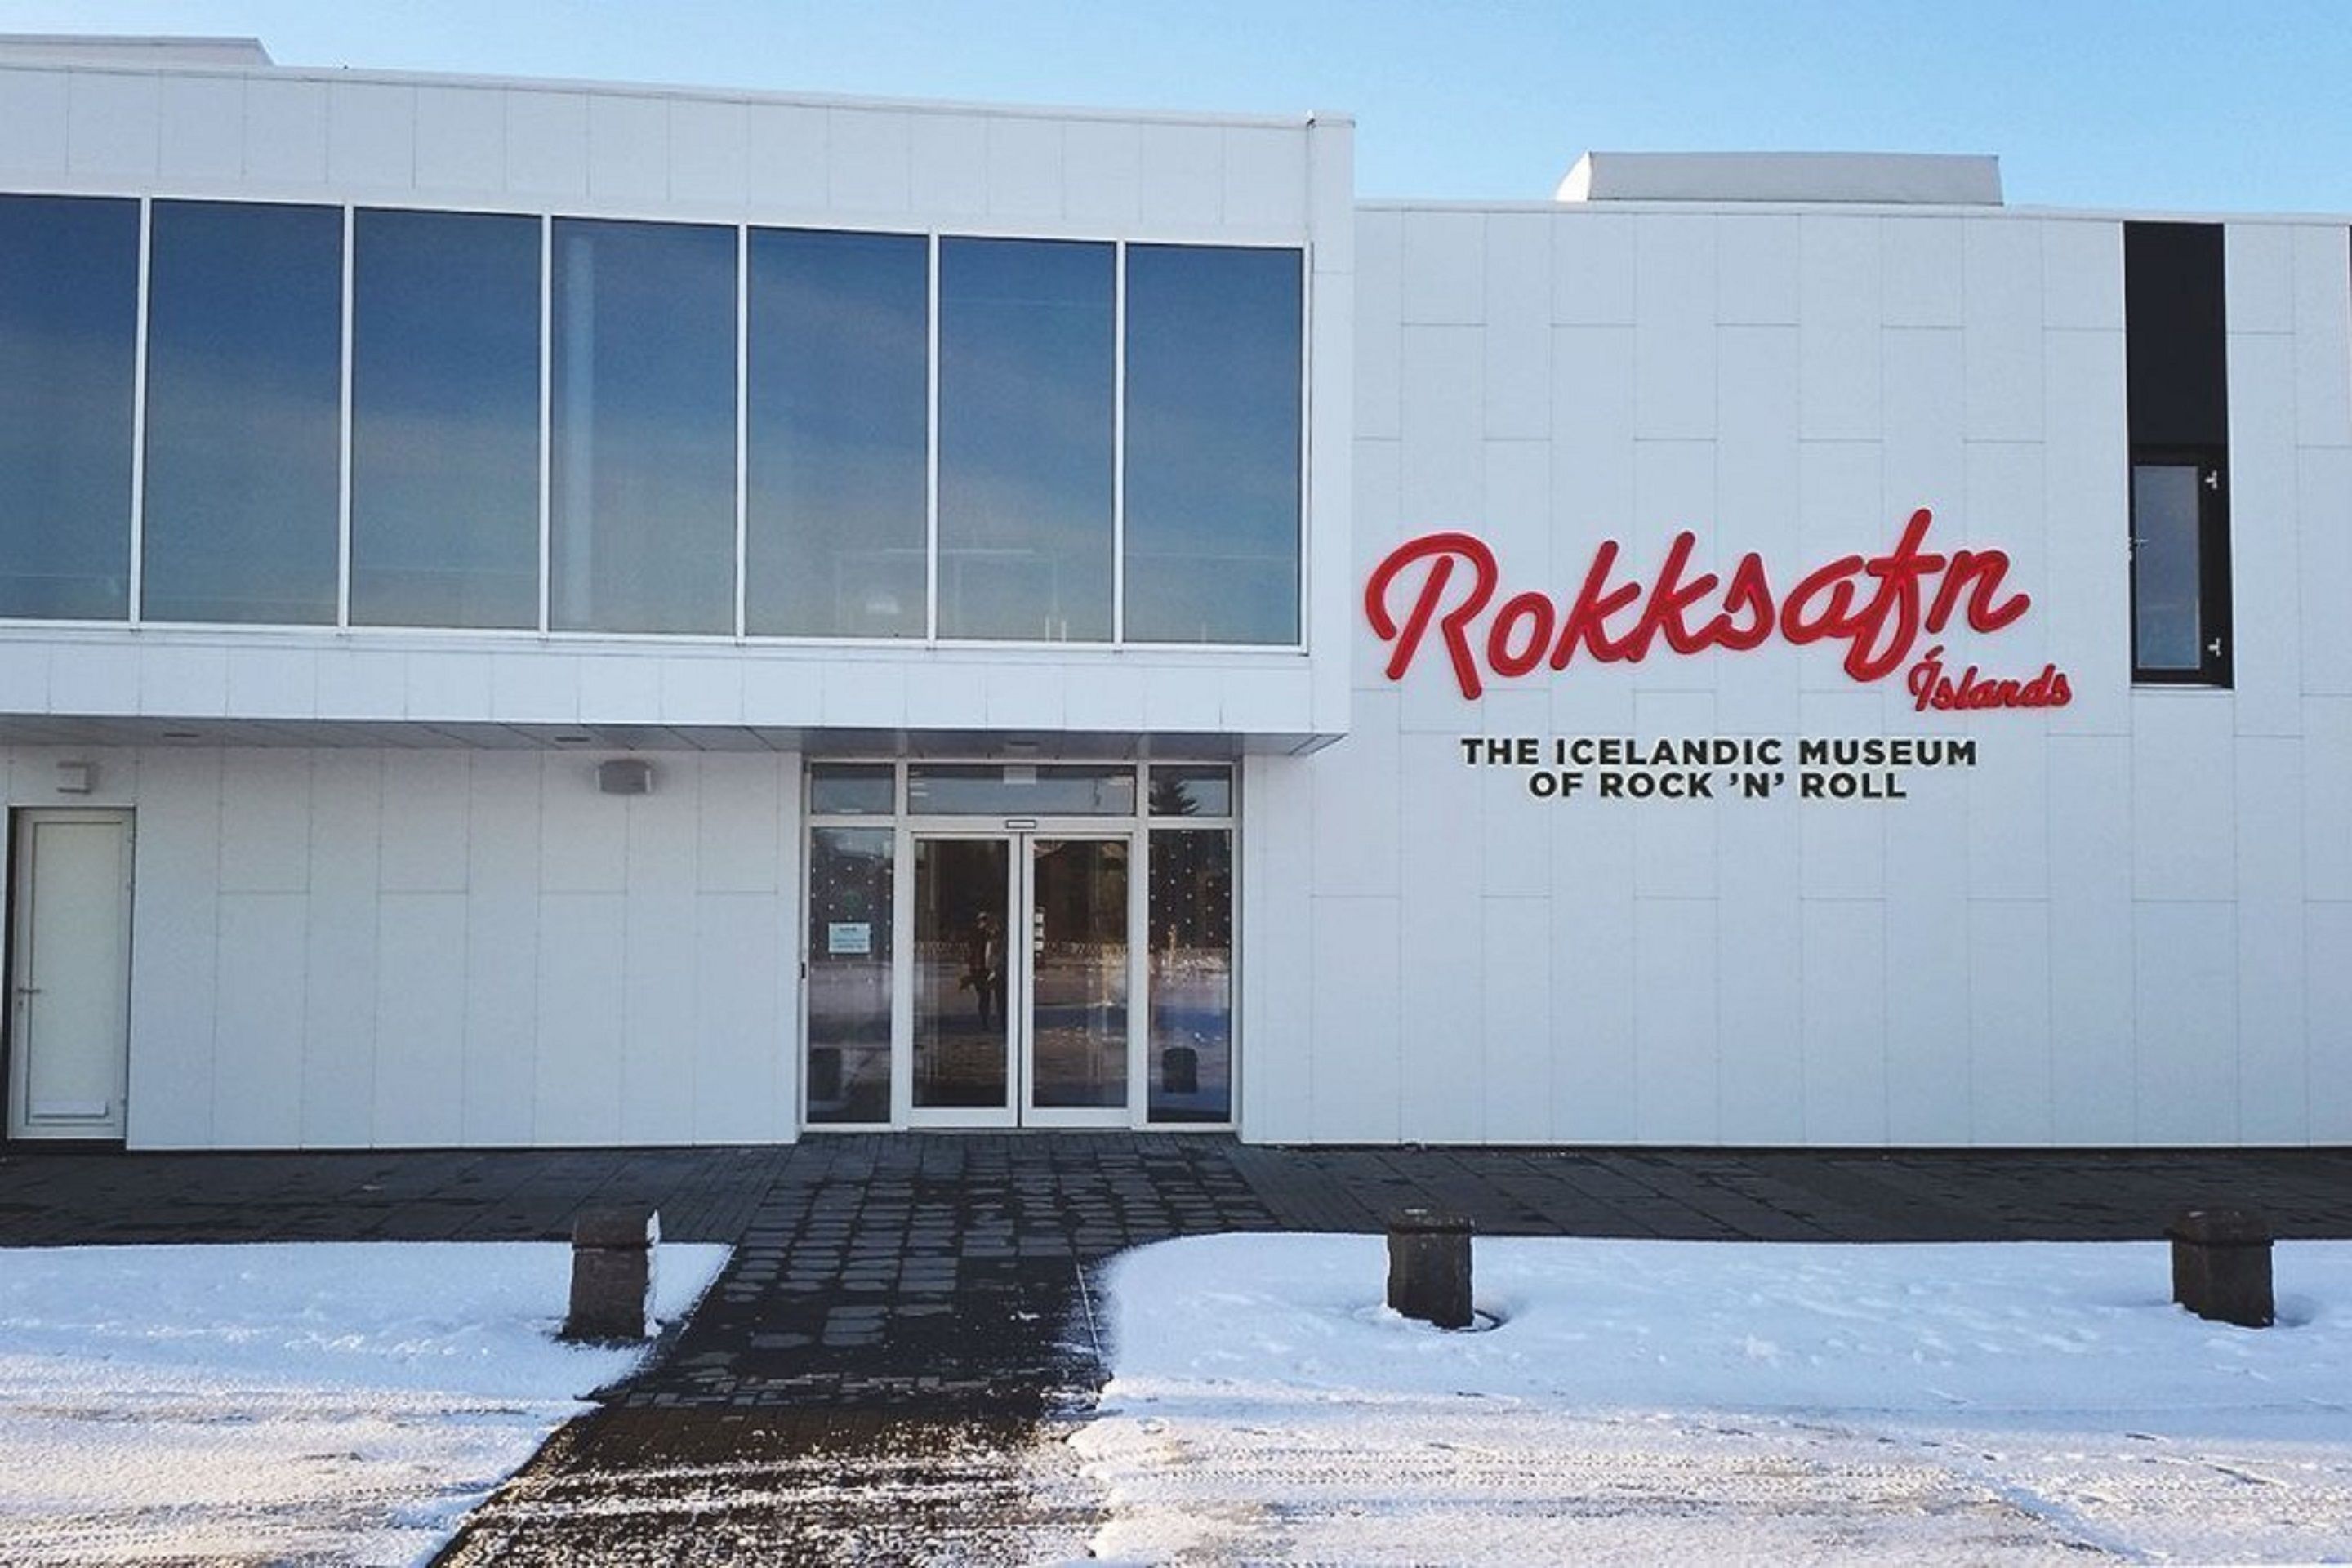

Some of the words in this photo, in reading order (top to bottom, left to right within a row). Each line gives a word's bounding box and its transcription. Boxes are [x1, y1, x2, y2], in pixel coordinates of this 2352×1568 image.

[1364, 508, 2030, 699] Rokksafn
[1908, 645, 2072, 711] Íslands
[1462, 738, 1539, 764] THE
[1556, 738, 1782, 765] ICELANDIC
[1799, 739, 1976, 766] MUSEUM
[1530, 772, 1584, 798] OF
[1600, 772, 1713, 798] ROCK
[1801, 772, 1907, 799] ROLL
